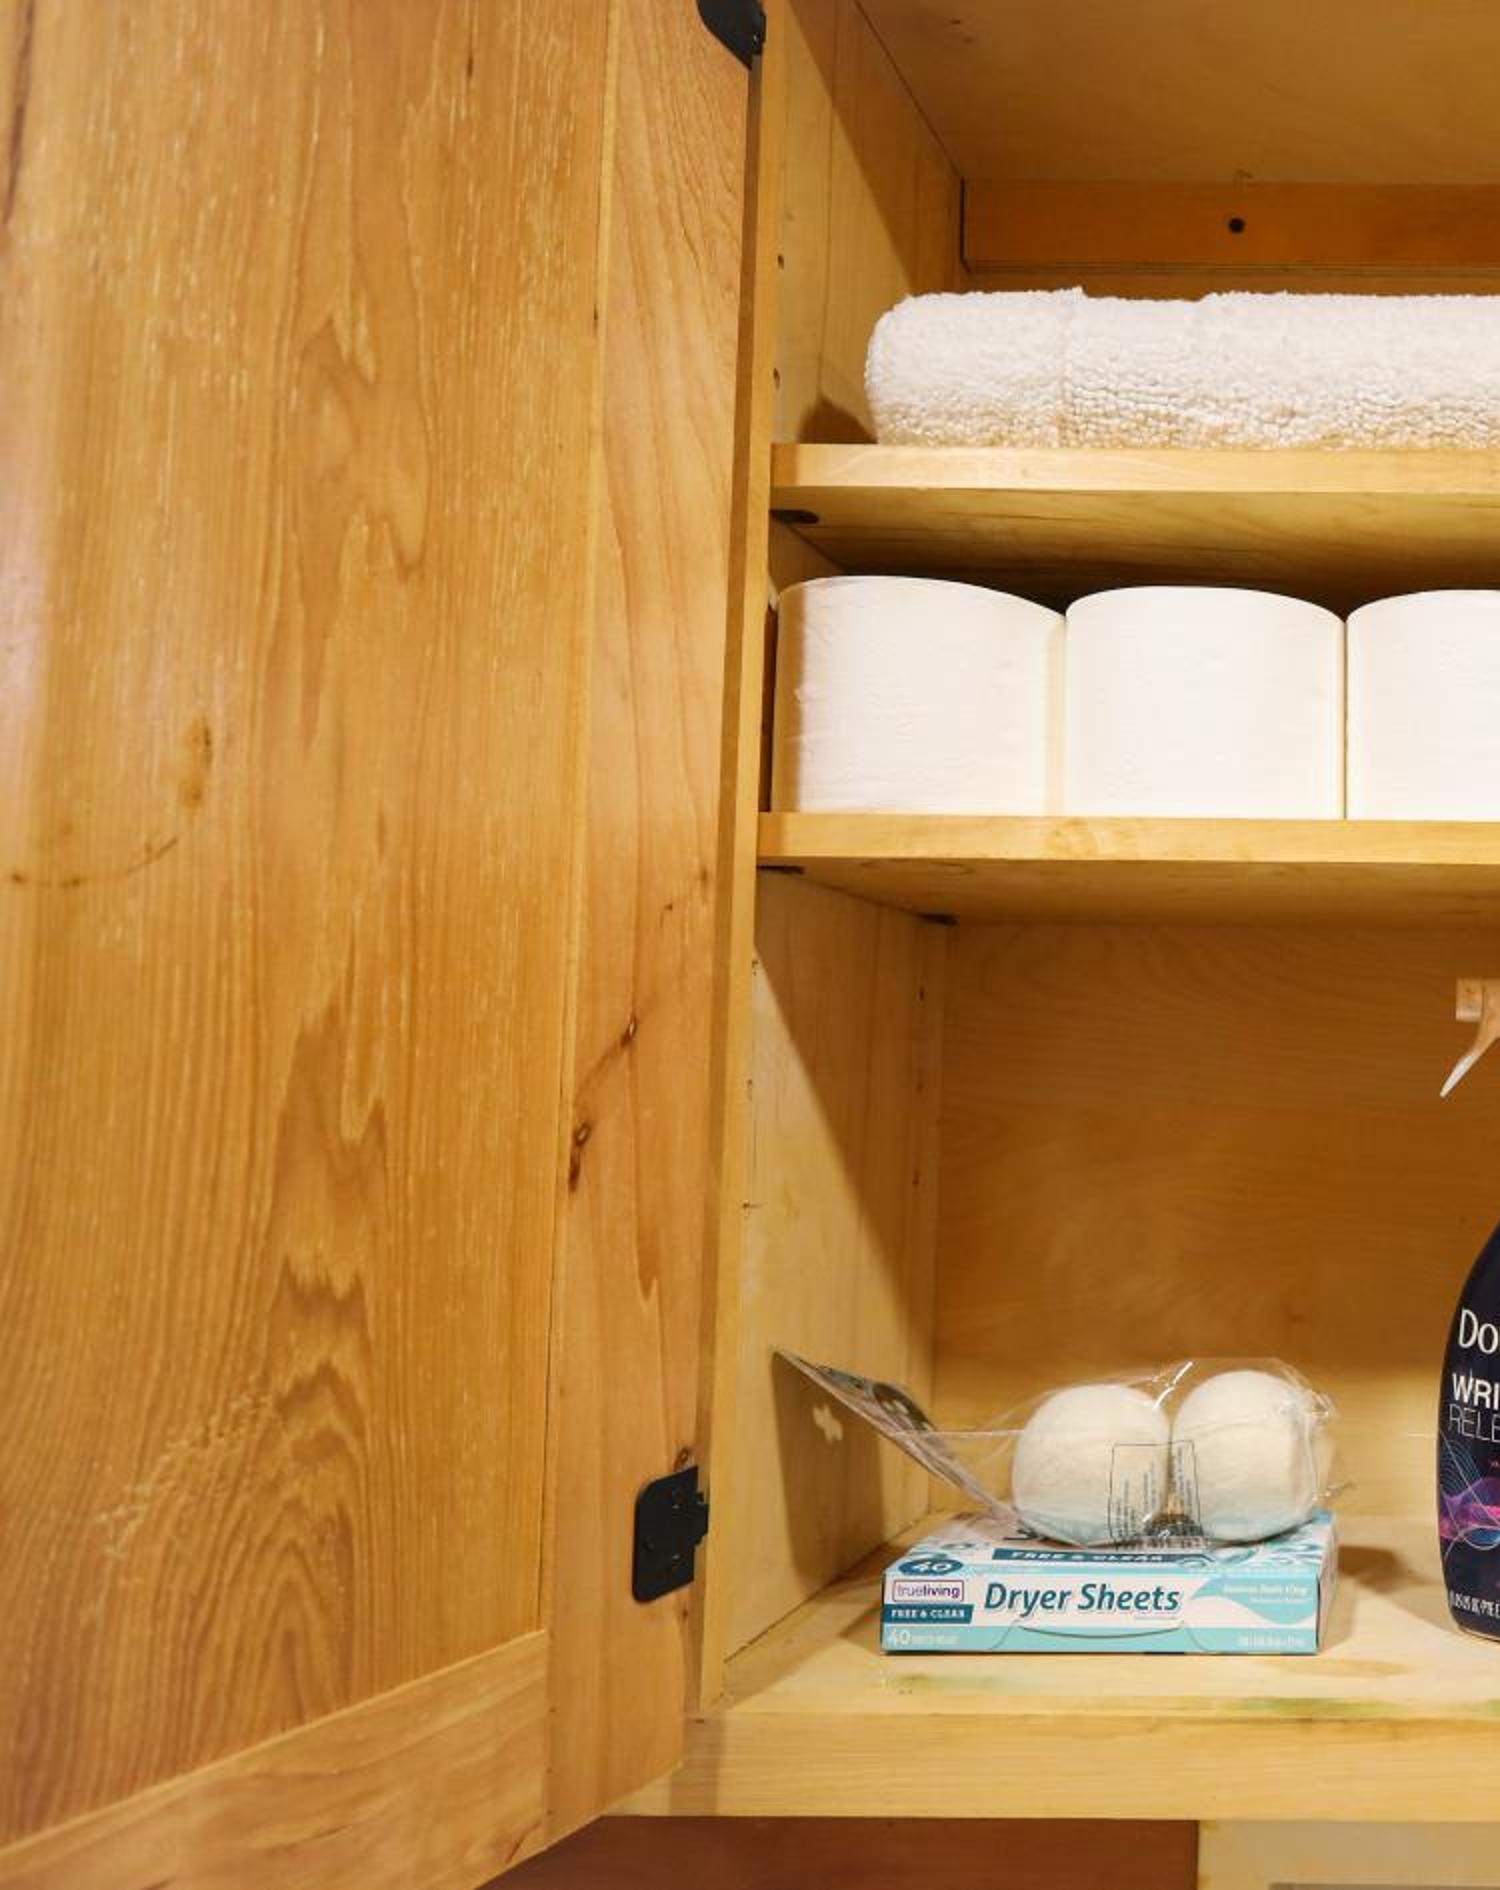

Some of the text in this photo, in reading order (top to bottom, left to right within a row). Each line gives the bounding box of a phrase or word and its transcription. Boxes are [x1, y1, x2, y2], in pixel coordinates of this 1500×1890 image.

[1011, 1551, 1065, 1560] FREE
[913, 1561, 953, 1573] 40
[897, 1584, 961, 1599] trueliving
[984, 1582, 1181, 1617] Dryer Sheets
[891, 1608, 965, 1618] FREE & CLEAR
